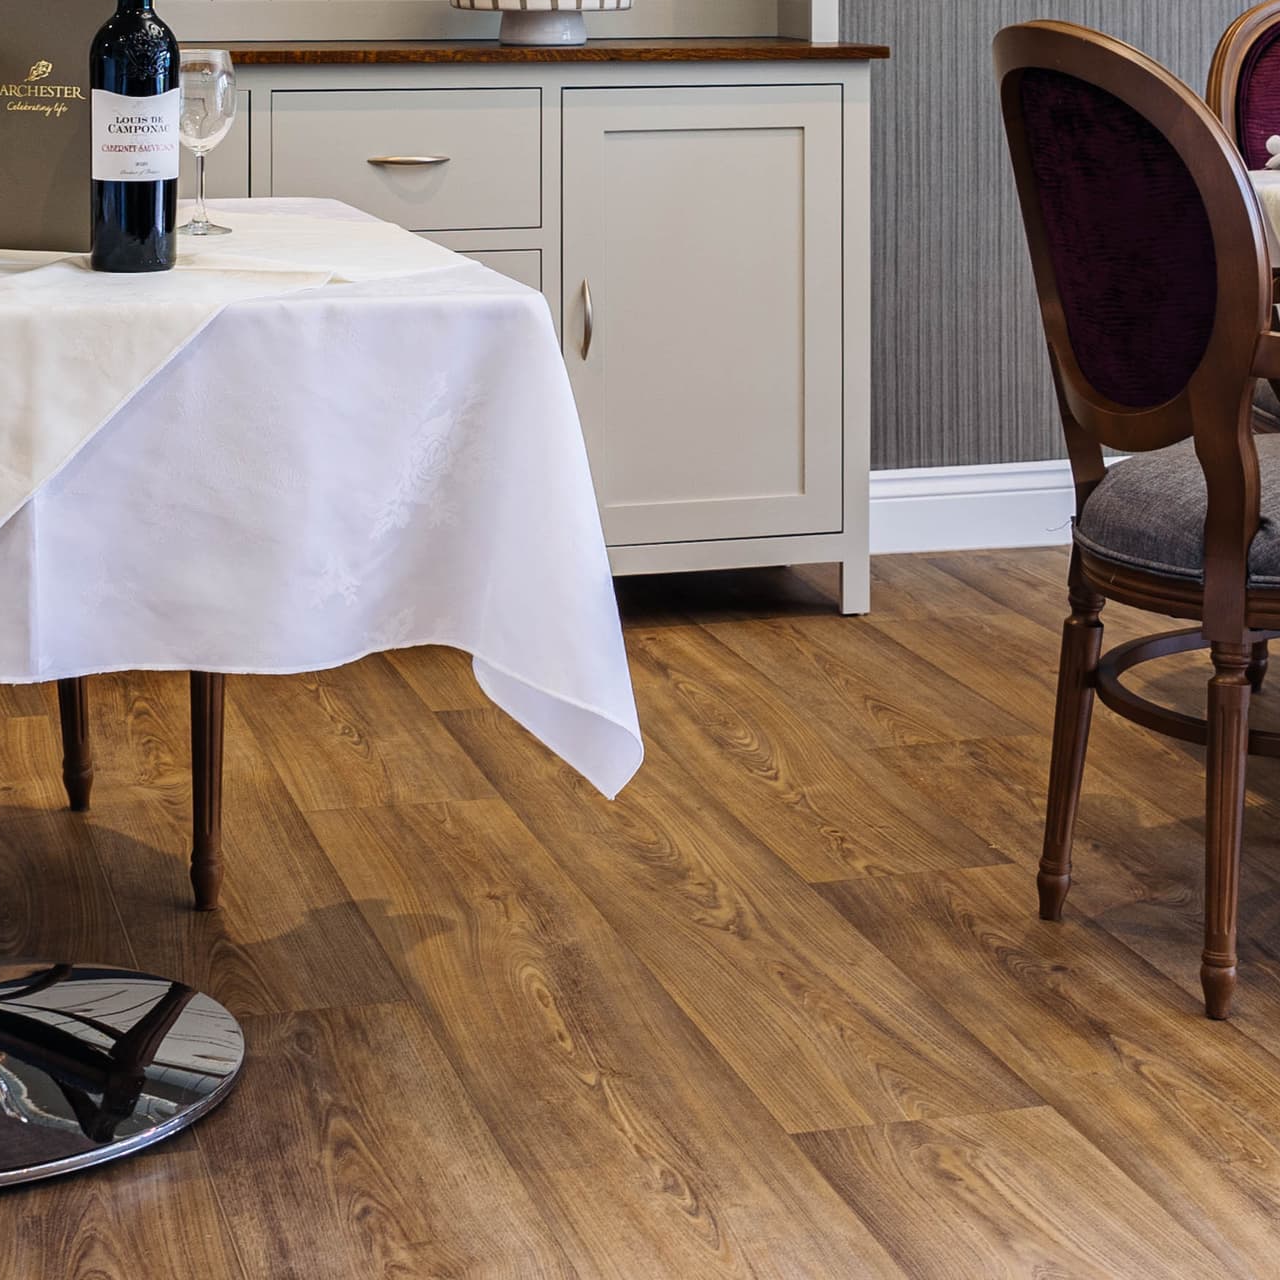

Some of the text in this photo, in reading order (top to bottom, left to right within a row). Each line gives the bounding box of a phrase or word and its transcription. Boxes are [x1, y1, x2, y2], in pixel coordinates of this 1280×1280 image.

[6, 101, 68, 117] Celebrating life
[116, 116, 164, 124] LOUIS DE
[107, 124, 169, 134] CAMPONAC
[101, 144, 137, 152] CABERNET
